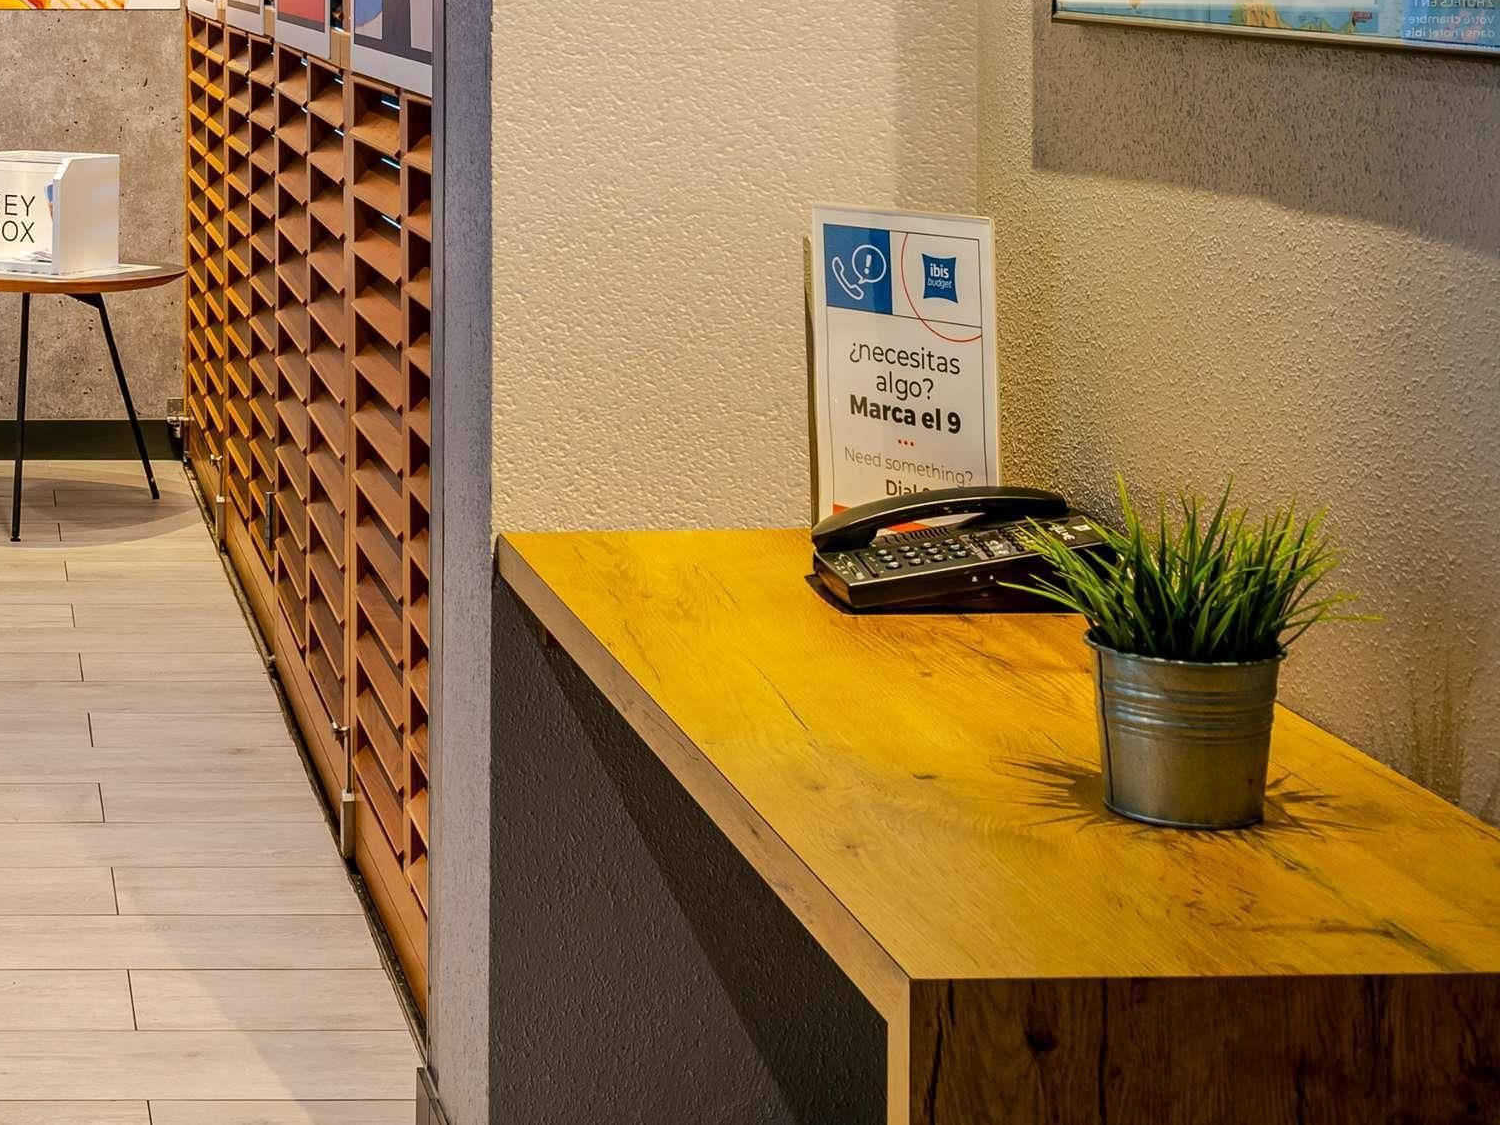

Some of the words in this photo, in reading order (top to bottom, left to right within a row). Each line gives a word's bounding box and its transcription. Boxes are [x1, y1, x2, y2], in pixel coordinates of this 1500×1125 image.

[927, 277, 952, 290] budget
[930, 262, 949, 278] ibis
[849, 342, 961, 375] ¿necesitas
[876, 371, 934, 401] algo?
[850, 394, 917, 426] Marca
[921, 408, 941, 431] el
[947, 411, 961, 434] 9
[844, 446, 882, 468] Need
[885, 457, 973, 487] something?
[886, 479, 917, 496] Dial
